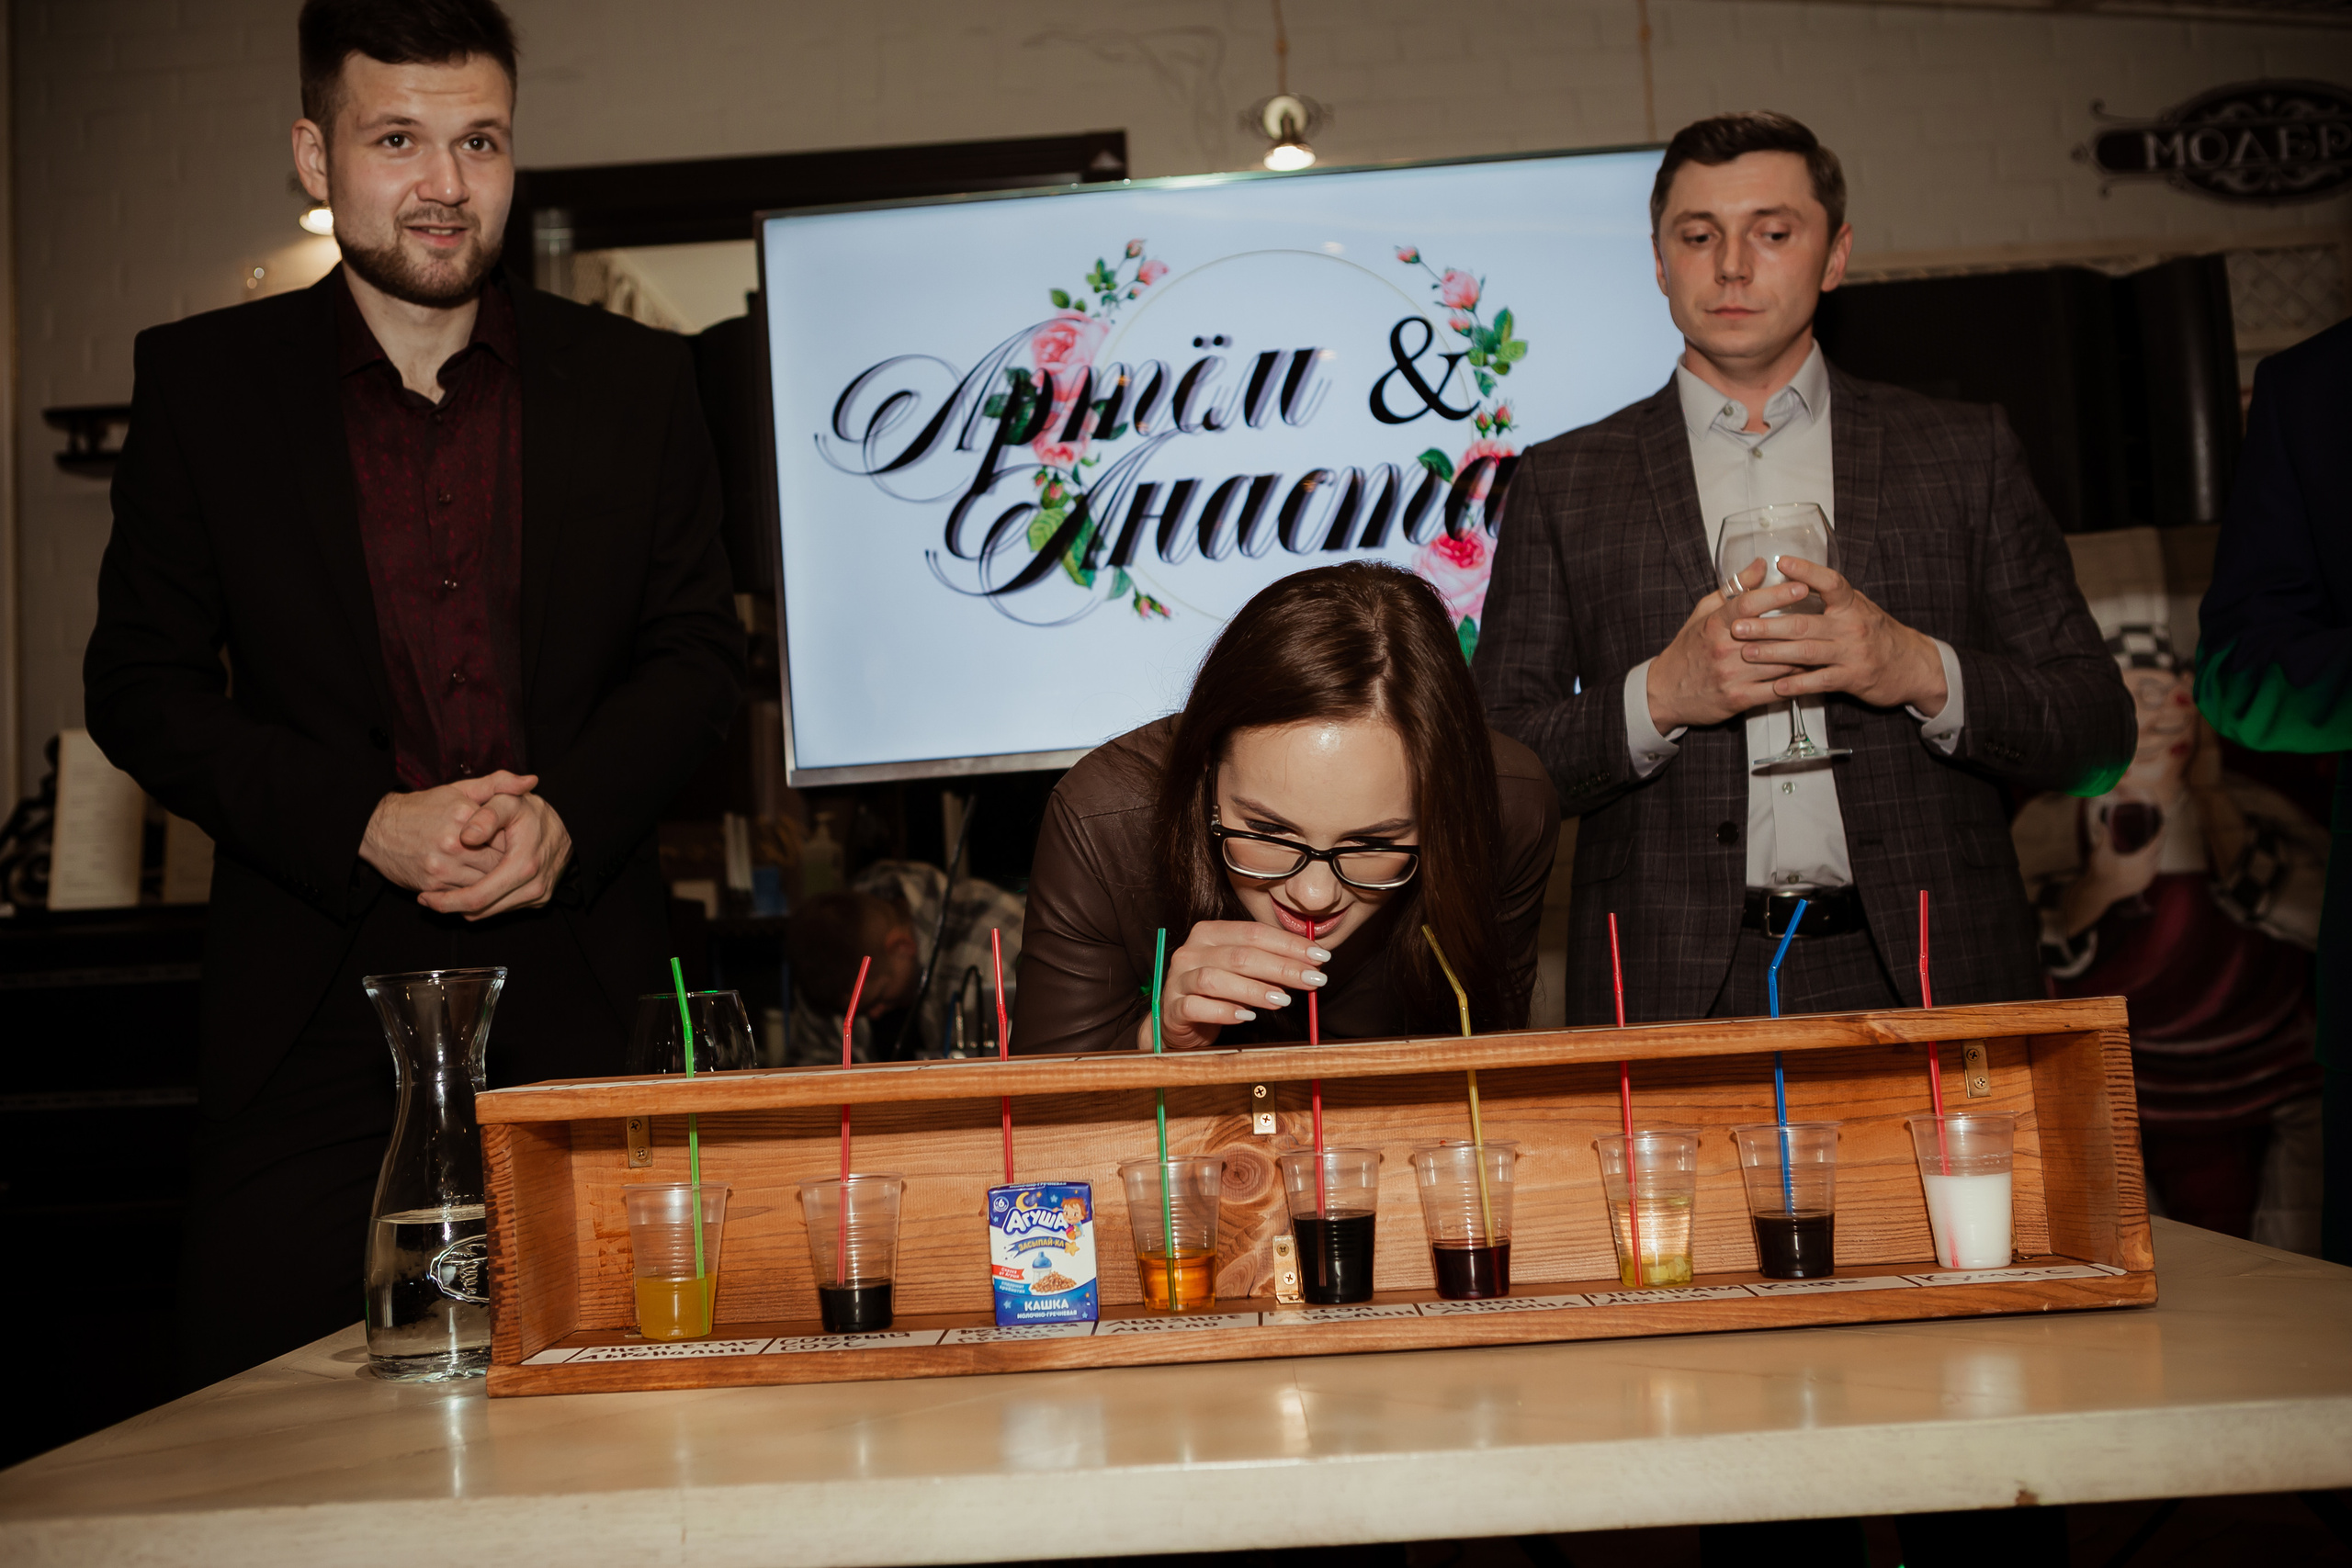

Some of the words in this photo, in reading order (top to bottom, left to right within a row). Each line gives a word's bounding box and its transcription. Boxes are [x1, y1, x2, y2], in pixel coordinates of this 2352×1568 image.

[814, 317, 1331, 502] Артём
[1369, 316, 1479, 424] &
[1024, 1299, 1069, 1311] КАШКА
[1017, 1310, 1077, 1319] МОЛОЧНО-ГРЕЧНЕВАЯ
